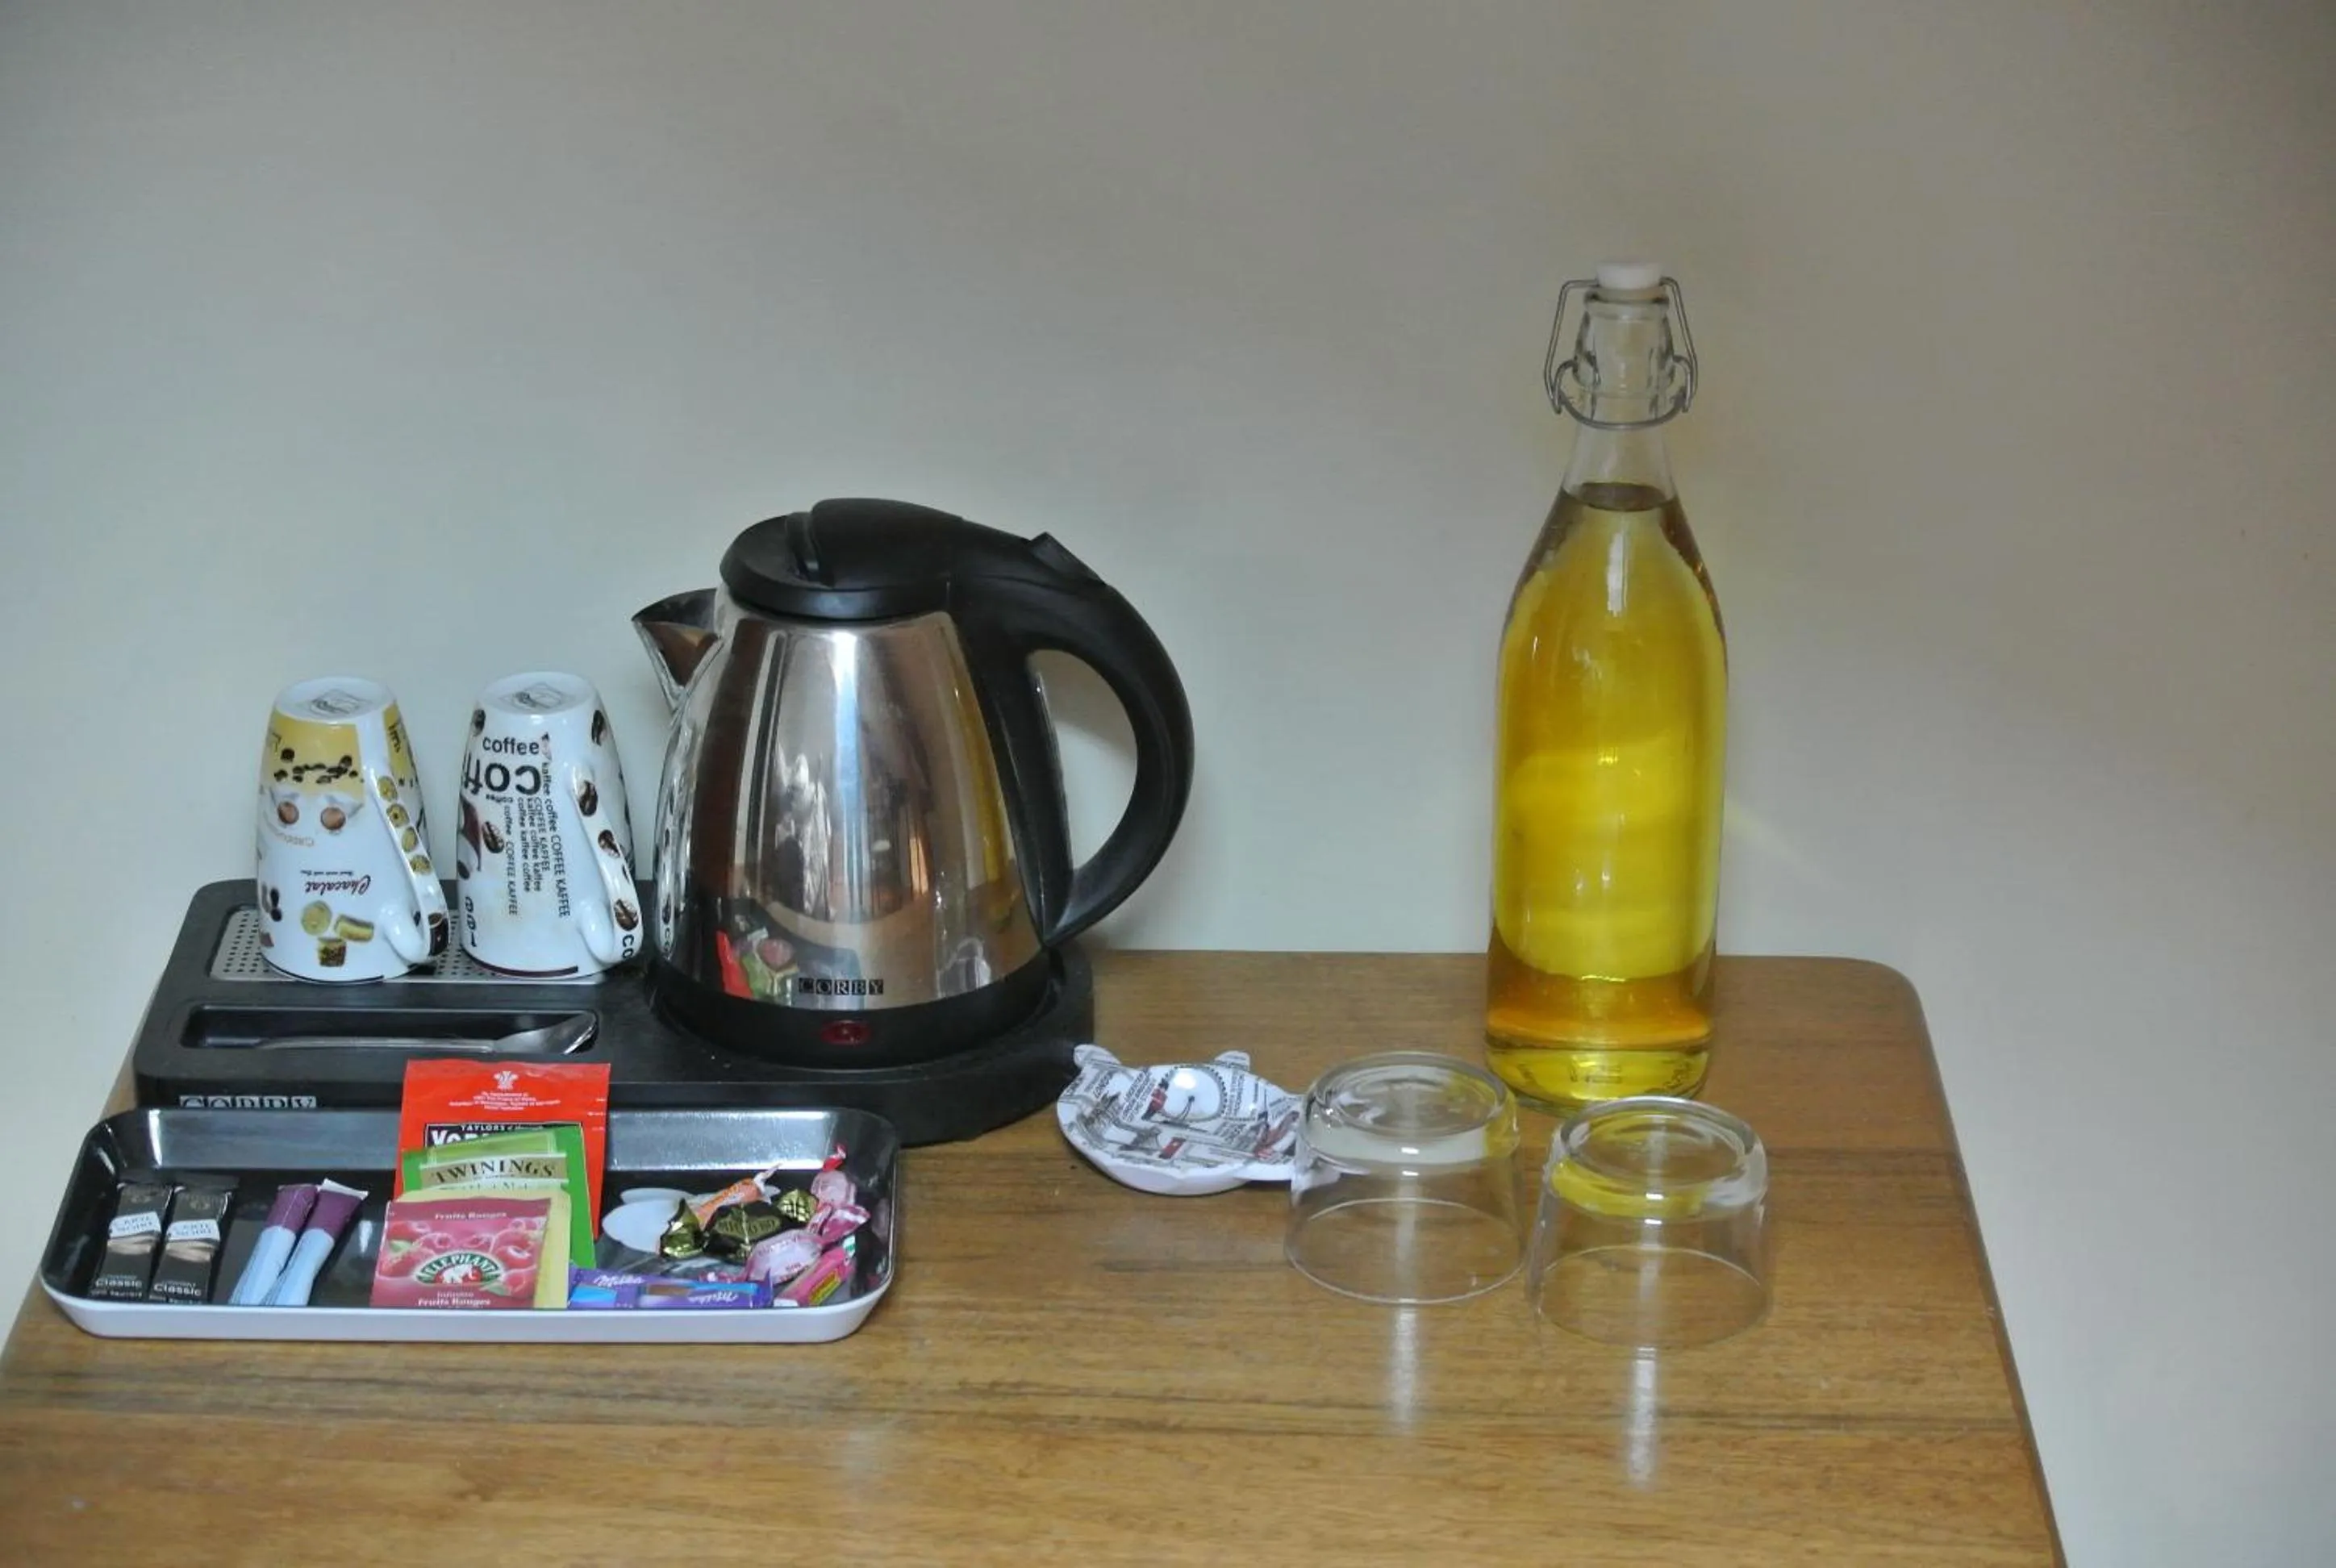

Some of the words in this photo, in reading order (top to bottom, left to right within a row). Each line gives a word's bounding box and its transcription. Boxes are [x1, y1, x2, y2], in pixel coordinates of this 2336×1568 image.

[482, 736, 539, 755] coffee
[544, 799, 558, 832] coffee
[534, 797, 546, 833] COFFEE
[540, 836, 550, 872] KAFFEE
[551, 834, 565, 876] COFFEE
[556, 878, 571, 918] KAFFEE
[799, 978, 883, 995] CORBY
[433, 1159, 555, 1183] TWININGS
[95, 1278, 142, 1287] Classic
[153, 1282, 202, 1296] Classic
[593, 1274, 645, 1288] Milka
